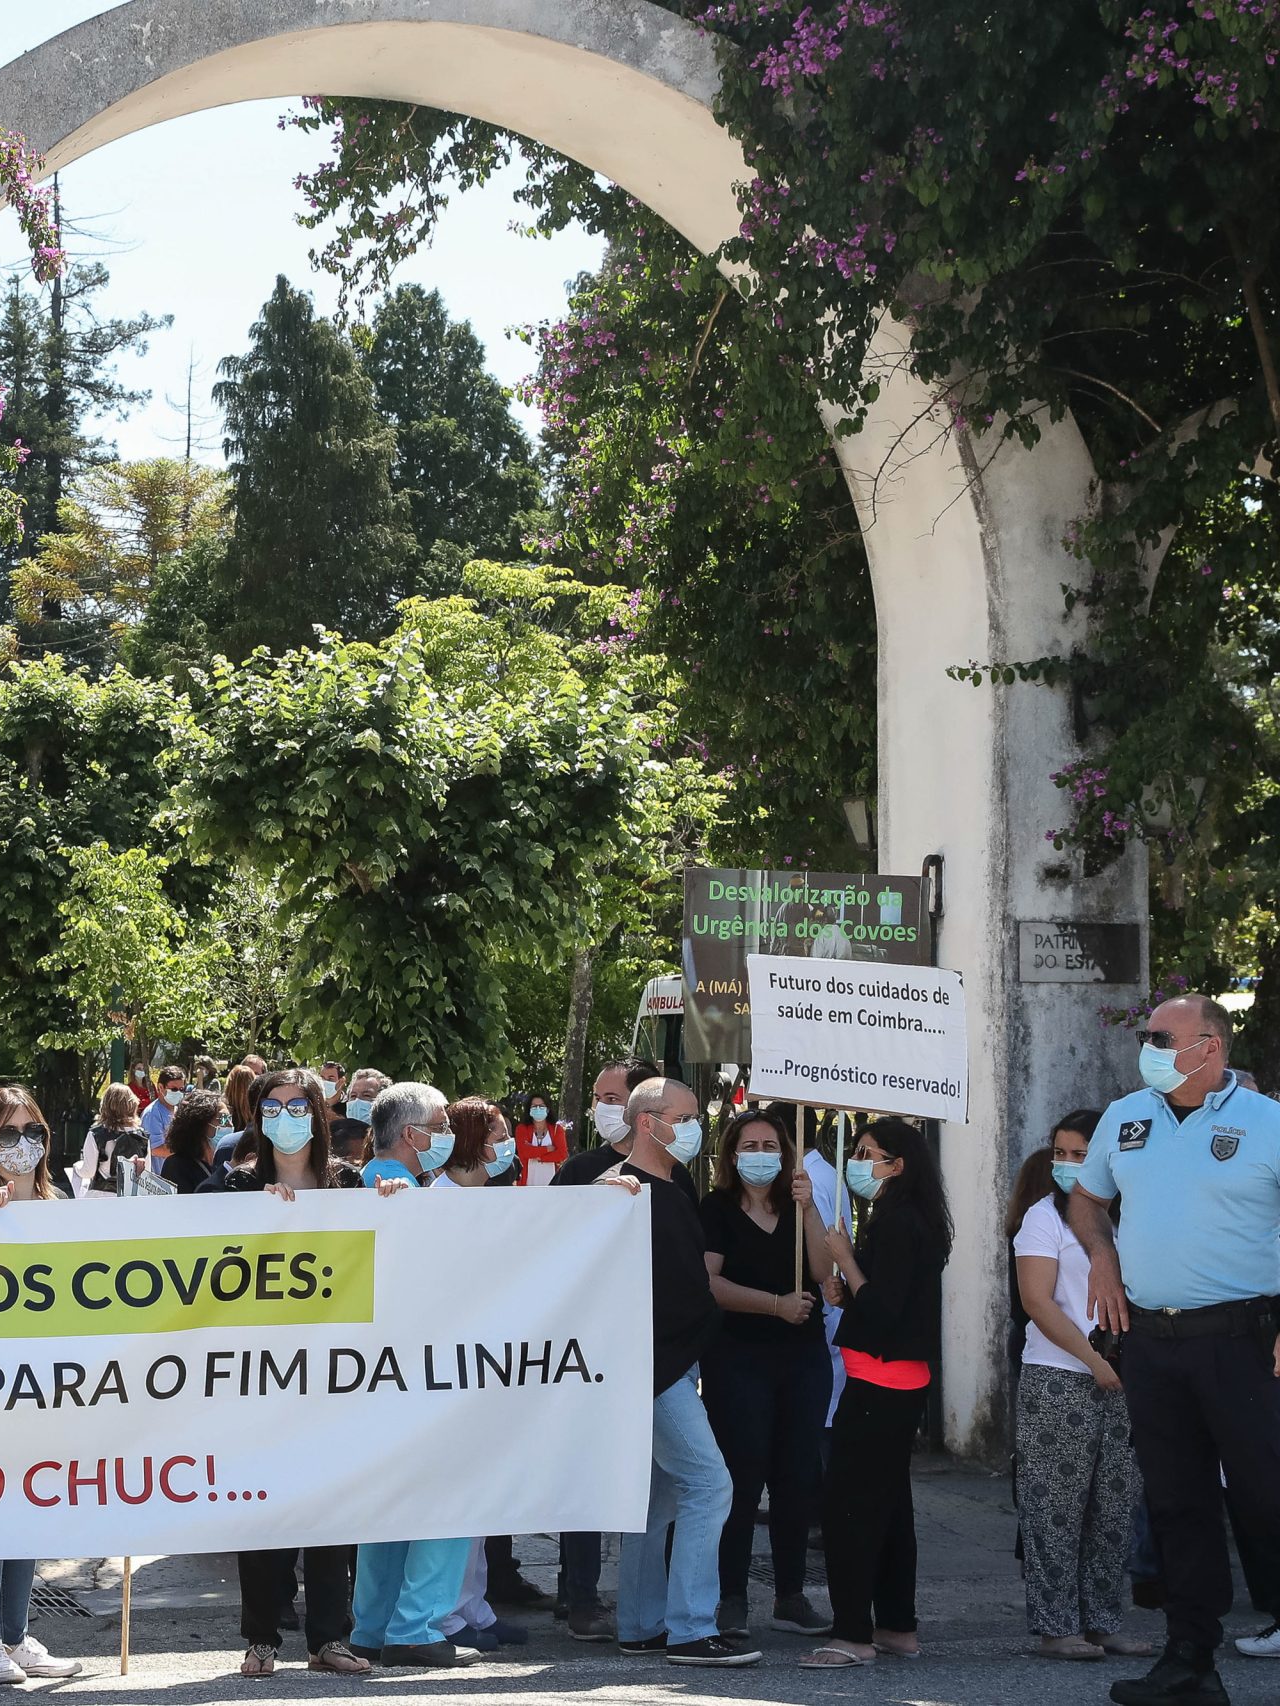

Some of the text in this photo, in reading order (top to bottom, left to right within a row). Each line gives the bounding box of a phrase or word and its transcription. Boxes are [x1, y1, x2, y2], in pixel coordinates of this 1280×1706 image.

[709, 880, 903, 909] Desvalorização da
[693, 914, 917, 942] Urgência dos Covões
[1034, 954, 1057, 969] DO
[696, 981, 705, 992] A
[709, 979, 742, 996] (MÁ)
[770, 973, 821, 992] Futuro
[827, 977, 853, 995] dos
[859, 981, 928, 1002] cuidados
[933, 986, 949, 1005] de
[647, 996, 685, 1010] AMBULA
[778, 1002, 822, 1021] saúde
[829, 1010, 852, 1024] em
[883, 1075, 960, 1098] reservado!
[72, 1246, 332, 1309] COVÕES:
[146, 1355, 186, 1399] O
[205, 1349, 307, 1397] FIM
[328, 1347, 408, 1394] DA
[425, 1339, 603, 1390] LINHA.
[23, 1455, 267, 1507] CHUC!...
